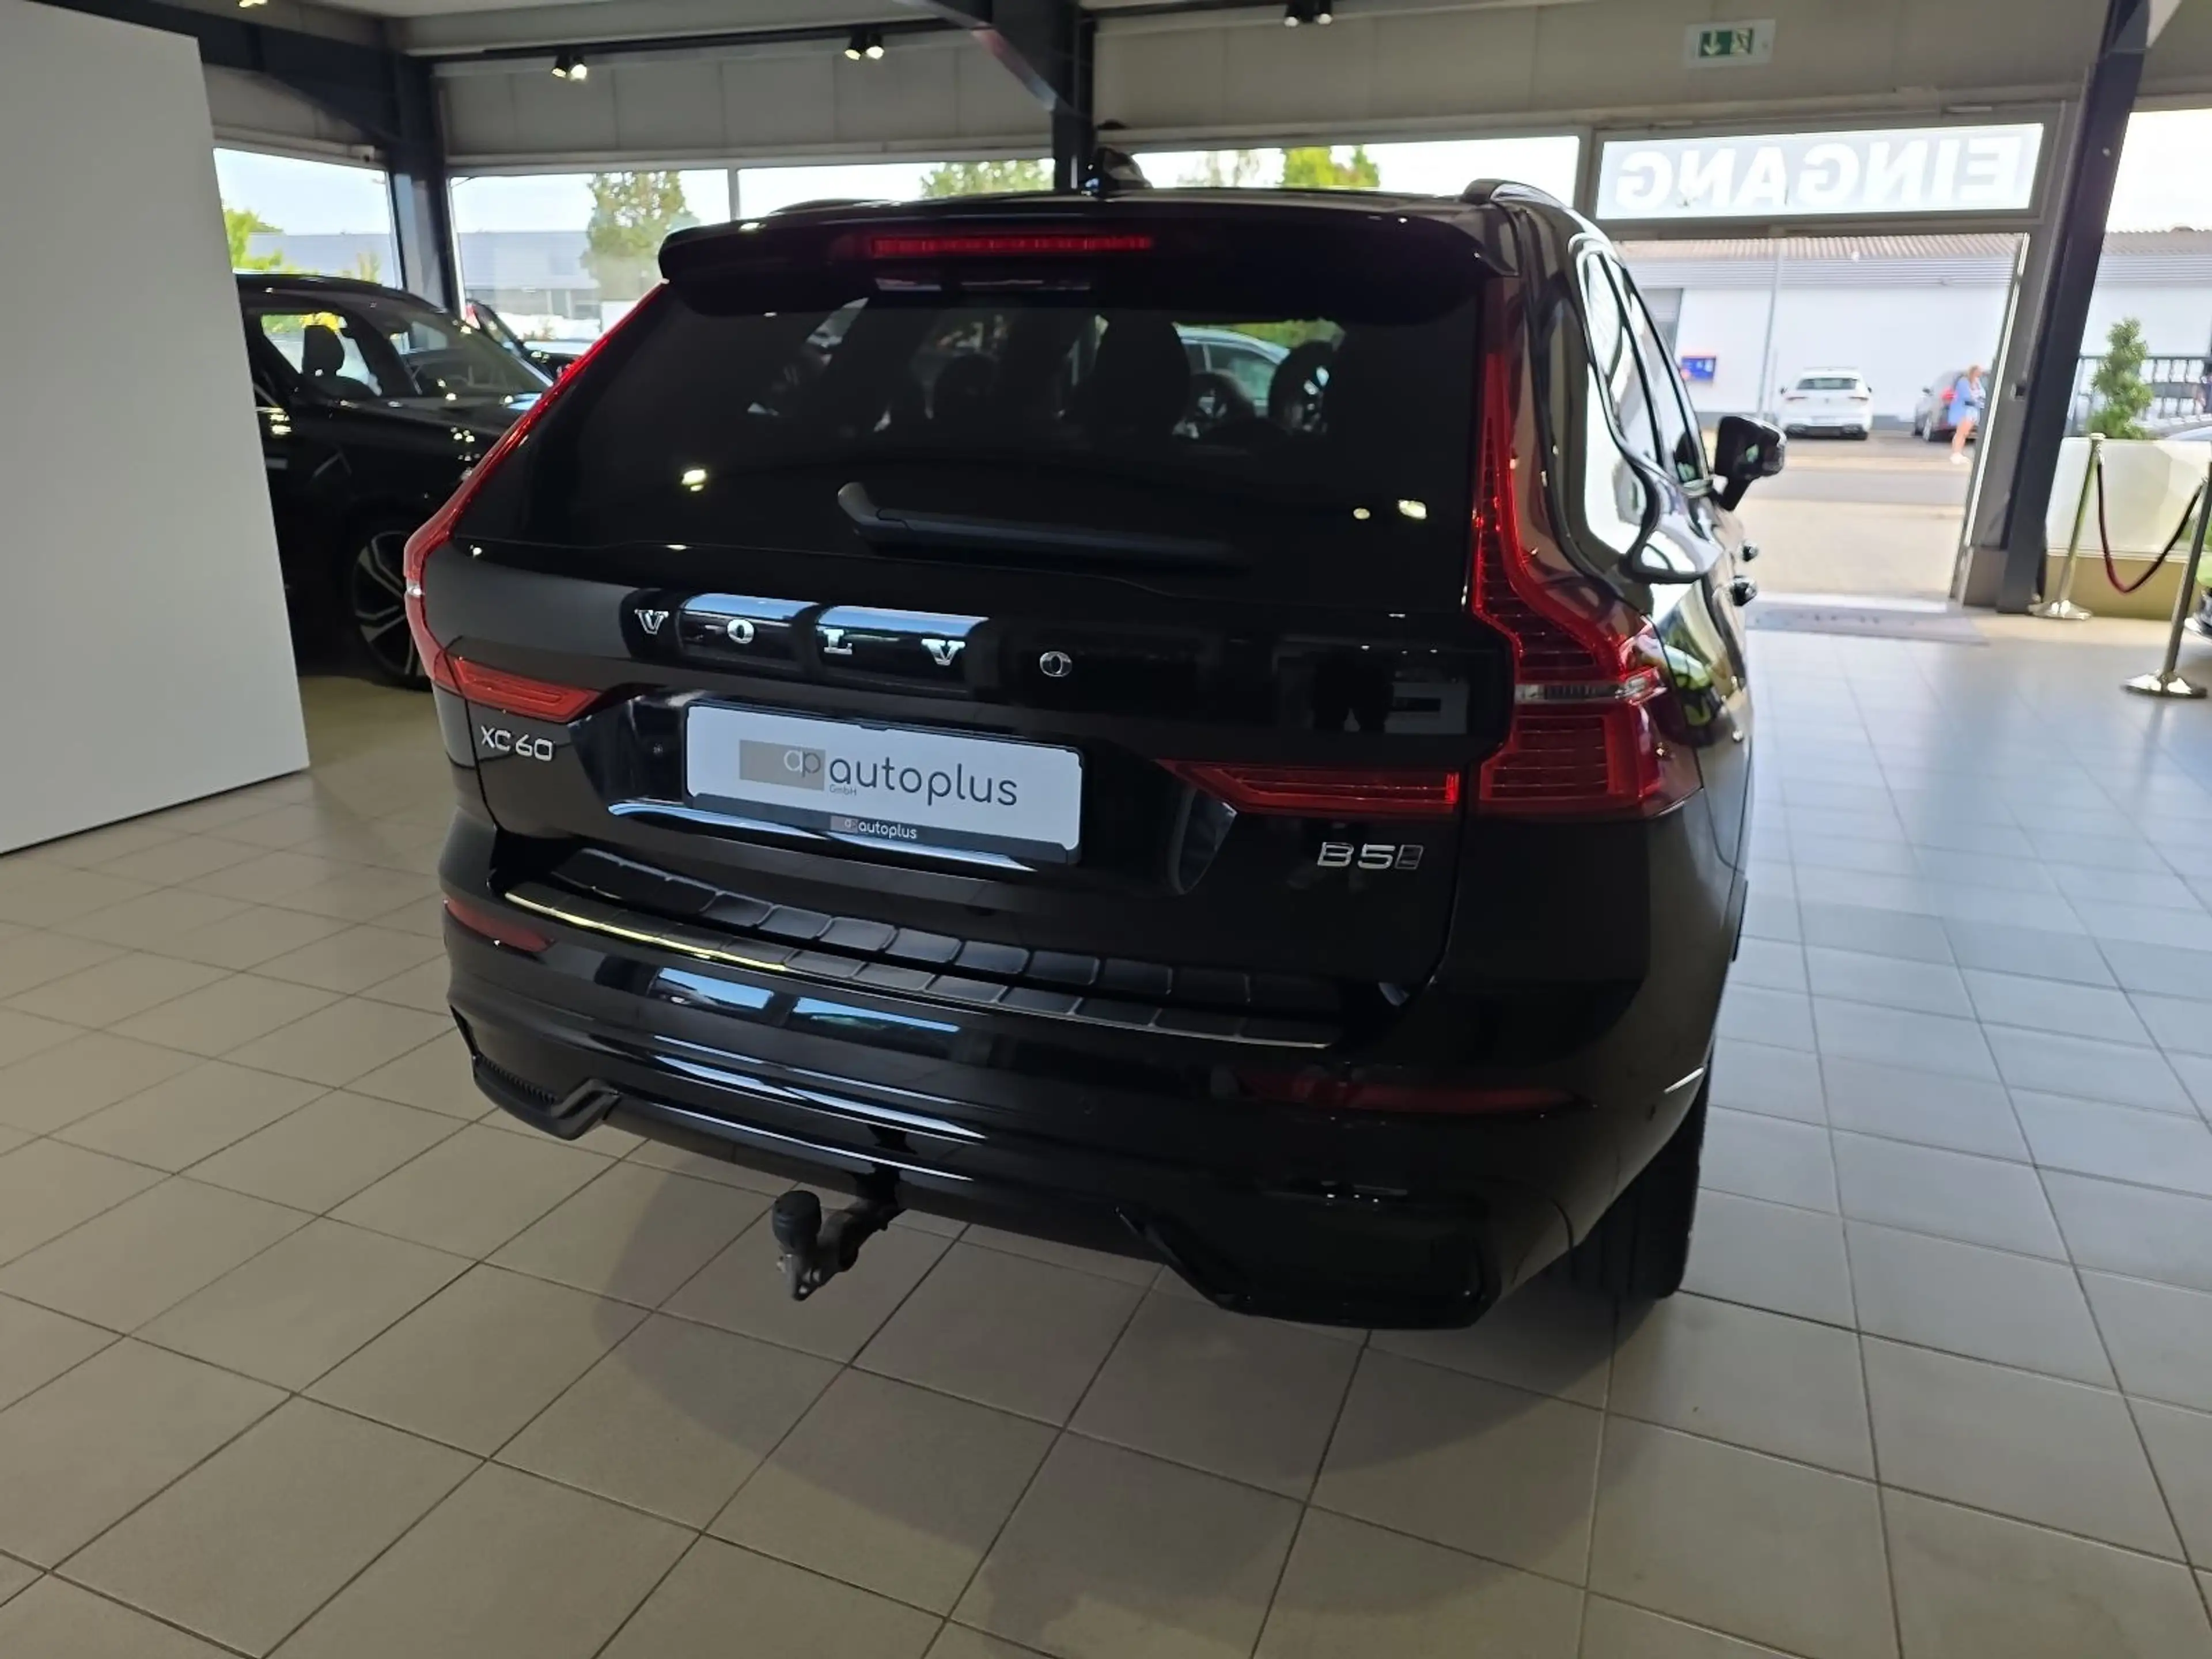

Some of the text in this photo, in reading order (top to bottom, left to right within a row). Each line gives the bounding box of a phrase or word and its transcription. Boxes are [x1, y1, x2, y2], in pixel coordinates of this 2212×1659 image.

[634, 609, 1072, 678] VOLVO
[481, 725, 553, 762] XC60
[830, 757, 1018, 806] autoplus
[859, 821, 918, 839] autoplus
[1317, 842, 1395, 869] B5
